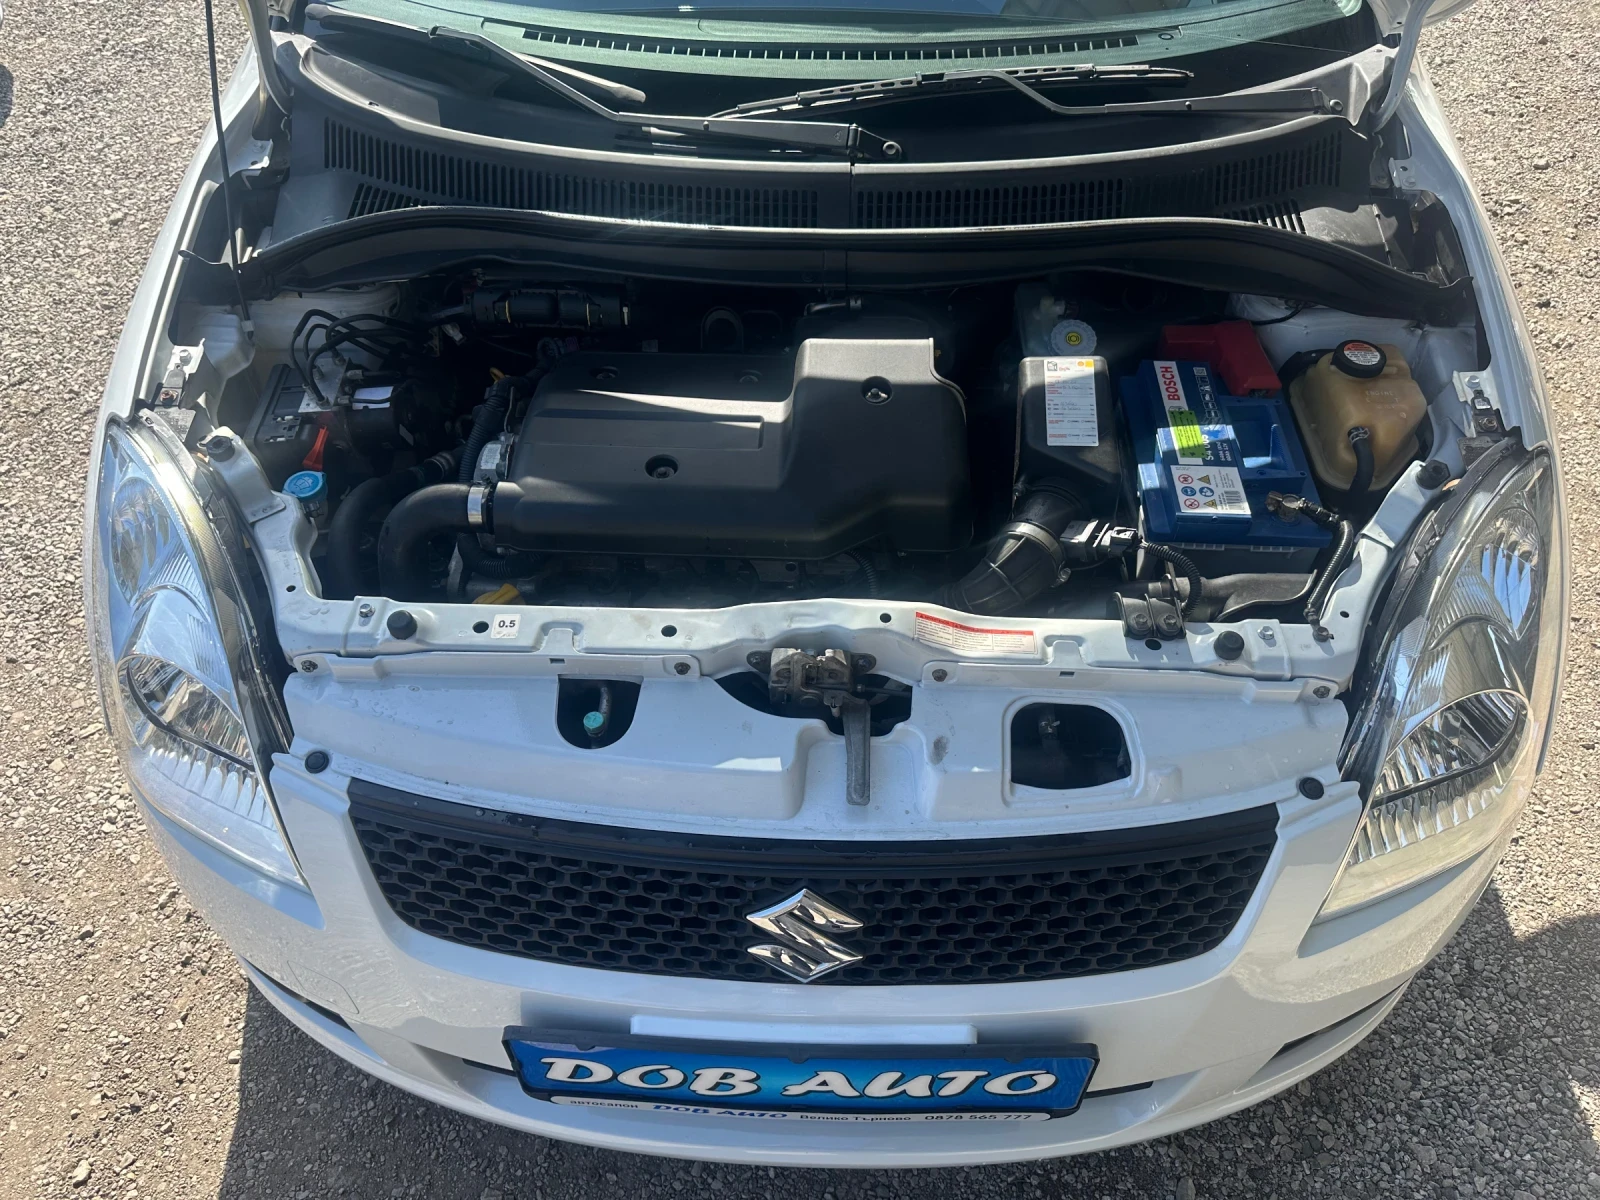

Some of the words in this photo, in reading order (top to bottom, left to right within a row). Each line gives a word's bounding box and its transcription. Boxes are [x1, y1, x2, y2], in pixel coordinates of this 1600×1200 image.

[1161, 366, 1181, 401] BOSCH
[498, 619, 516, 628] 0.5
[540, 1057, 762, 1097] DOB
[780, 1070, 1058, 1098] AUTO
[569, 1099, 639, 1109] автосалон
[652, 1104, 710, 1114] DOB
